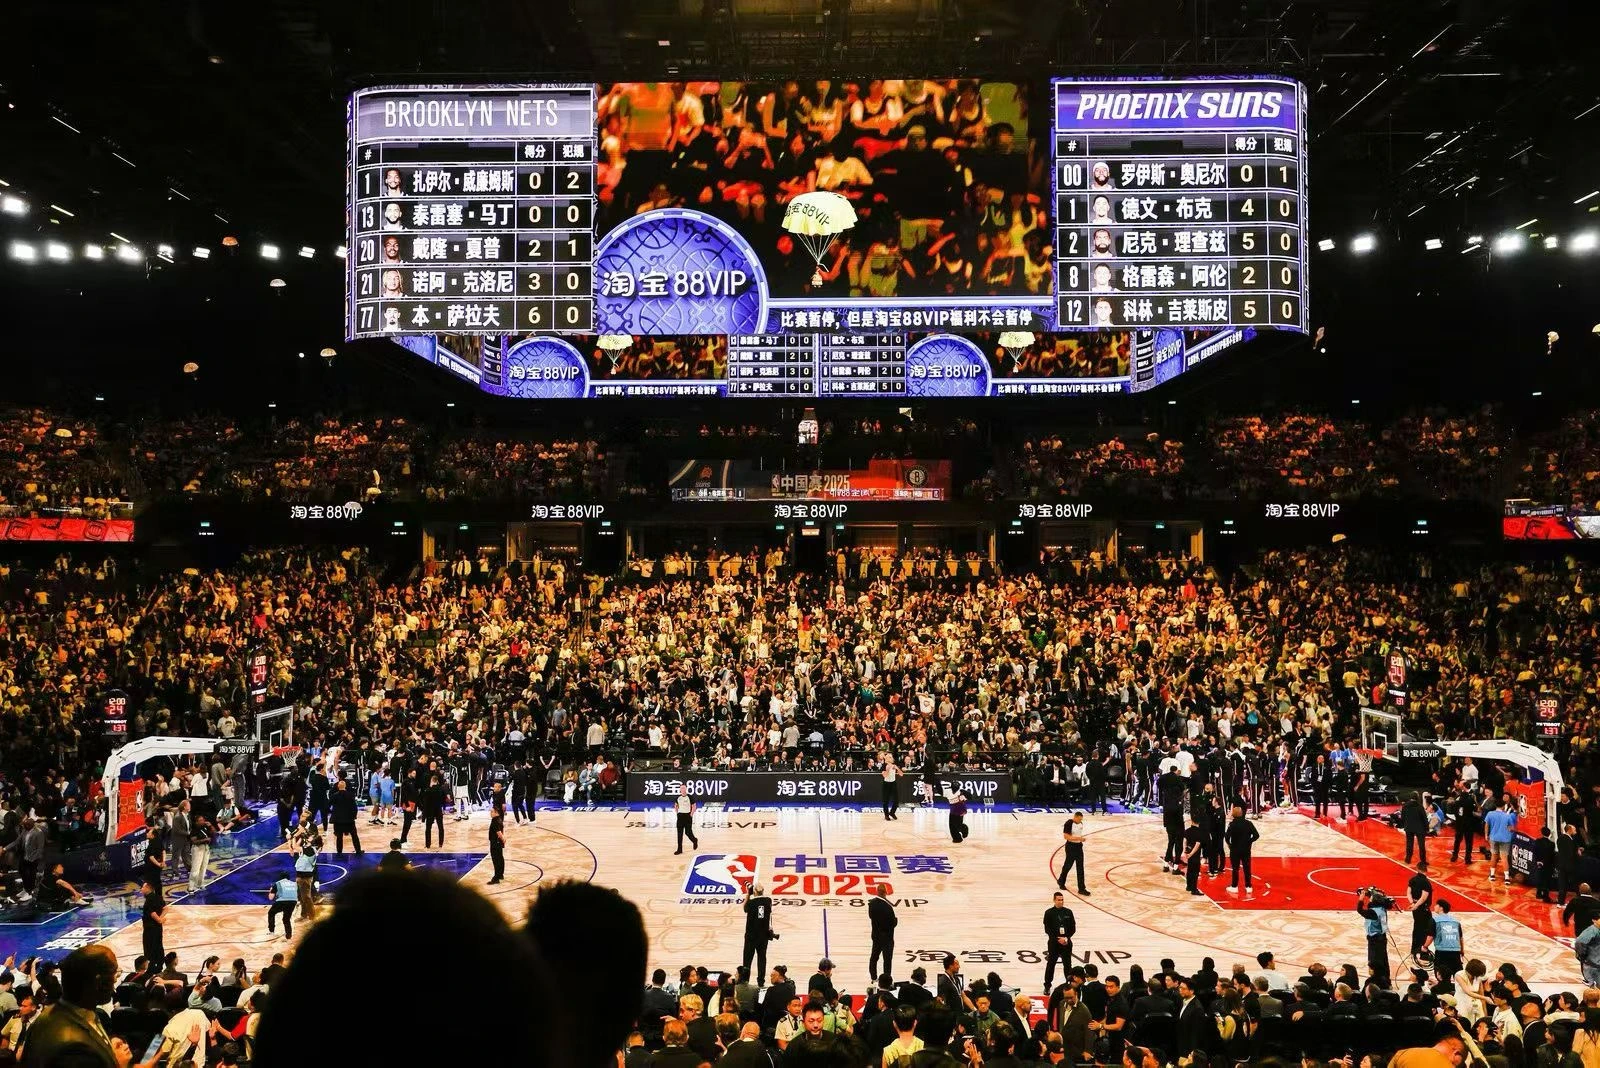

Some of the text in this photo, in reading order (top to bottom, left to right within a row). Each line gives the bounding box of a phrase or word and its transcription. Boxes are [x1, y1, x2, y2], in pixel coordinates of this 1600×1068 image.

[385, 99, 558, 127] BROOKLYN NETS
[1076, 92, 1282, 119] PHOENIX SUNS
[364, 144, 584, 160] # 得分 犯规
[1067, 138, 1292, 152] # 得分 犯规
[1063, 164, 1082, 186] 00
[1241, 165, 1253, 182] 0
[1279, 166, 1287, 183] 1
[365, 173, 370, 194] 1
[529, 172, 541, 189] 0
[567, 172, 579, 189] 2
[361, 206, 374, 228] 13
[529, 206, 541, 223] 0
[567, 205, 579, 222] 0
[785, 202, 829, 226] 宝88VIP
[1069, 199, 1076, 219] 1
[1241, 199, 1254, 215] 4
[1279, 199, 1290, 216] 0
[1069, 232, 1078, 253] 2
[1242, 233, 1255, 250] 5
[1280, 233, 1291, 250] 0
[360, 240, 375, 261] 20
[529, 240, 541, 256] 2
[568, 240, 577, 256] 1
[361, 273, 373, 295] 21
[528, 273, 540, 290] 3
[567, 273, 579, 290] 0
[602, 270, 746, 297] 淘宝88VIP
[1069, 266, 1079, 288] 8
[1243, 267, 1255, 284] 2
[1281, 267, 1292, 284] 0
[360, 307, 374, 328] 77
[528, 307, 540, 324] 6
[567, 307, 579, 323] 0
[1067, 300, 1082, 321] 12
[1243, 301, 1256, 318] 5
[1282, 301, 1292, 318] 0
[789, 336, 796, 344] 0
[803, 336, 810, 344] 0
[881, 336, 888, 344] 4
[895, 336, 902, 344] 0
[789, 352, 796, 360] 2
[803, 352, 810, 360] 1
[881, 351, 888, 360] 5
[895, 351, 902, 360] 0
[509, 366, 580, 380] 淘宝88VIP
[789, 368, 796, 376] 3
[803, 368, 810, 376] 0
[881, 367, 888, 375] 2
[895, 367, 902, 375] 0
[910, 365, 981, 378] 淘宝88VIP
[789, 383, 796, 391] 6
[803, 383, 810, 391] 0
[881, 382, 888, 390] 5
[895, 382, 902, 390] 0
[532, 505, 604, 518] 淘宝88VIP
[774, 505, 847, 518] 淘宝88VIP
[1018, 504, 1092, 517] 淘宝88VIP
[1265, 504, 1339, 517] 淘宝88VIP
[777, 780, 861, 796] 淘宝88VIP
[774, 854, 953, 874] 中国赛
[692, 885, 727, 893] NBA
[771, 875, 894, 895] 2025
[772, 898, 928, 907] 淘宝8VIP
[905, 950, 1132, 964] 淘宝8VIP
